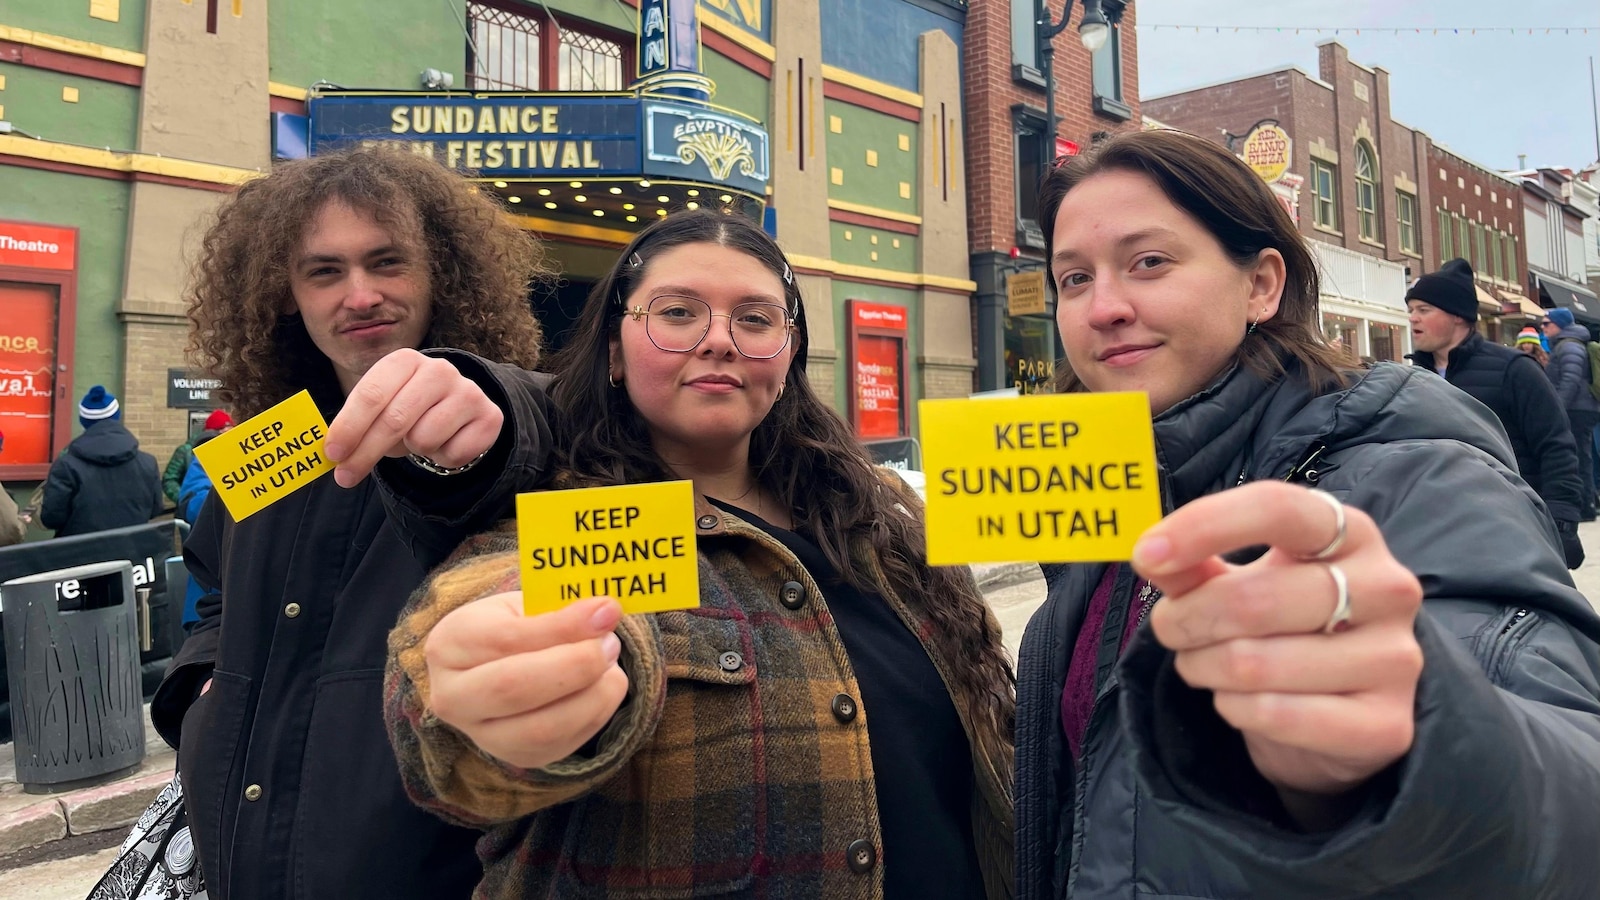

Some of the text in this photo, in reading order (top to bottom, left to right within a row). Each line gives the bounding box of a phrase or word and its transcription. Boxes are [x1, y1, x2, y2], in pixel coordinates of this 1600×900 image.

[644, 0, 665, 70] AN
[391, 105, 560, 134] SUNDANCE
[673, 120, 753, 153] EGYPTIAN
[1248, 140, 1286, 154] BANJO
[1258, 129, 1277, 141] RED
[447, 140, 601, 169] FESTIVAL
[1247, 152, 1285, 166] PIZZA
[0, 235, 59, 254] Theatre
[1018, 359, 1054, 377] PARK
[189, 390, 211, 400] LINE
[238, 421, 283, 455] KEEP
[994, 421, 1079, 450] KEEP
[221, 424, 324, 490] SUNDANCE
[250, 451, 322, 499] IN UTAH
[940, 462, 1144, 496] SUNDANCE
[575, 506, 640, 532] KEEP
[977, 508, 1119, 539] IN UTAH
[532, 536, 685, 570] SUNDANCE
[561, 572, 666, 601] IN UTAH
